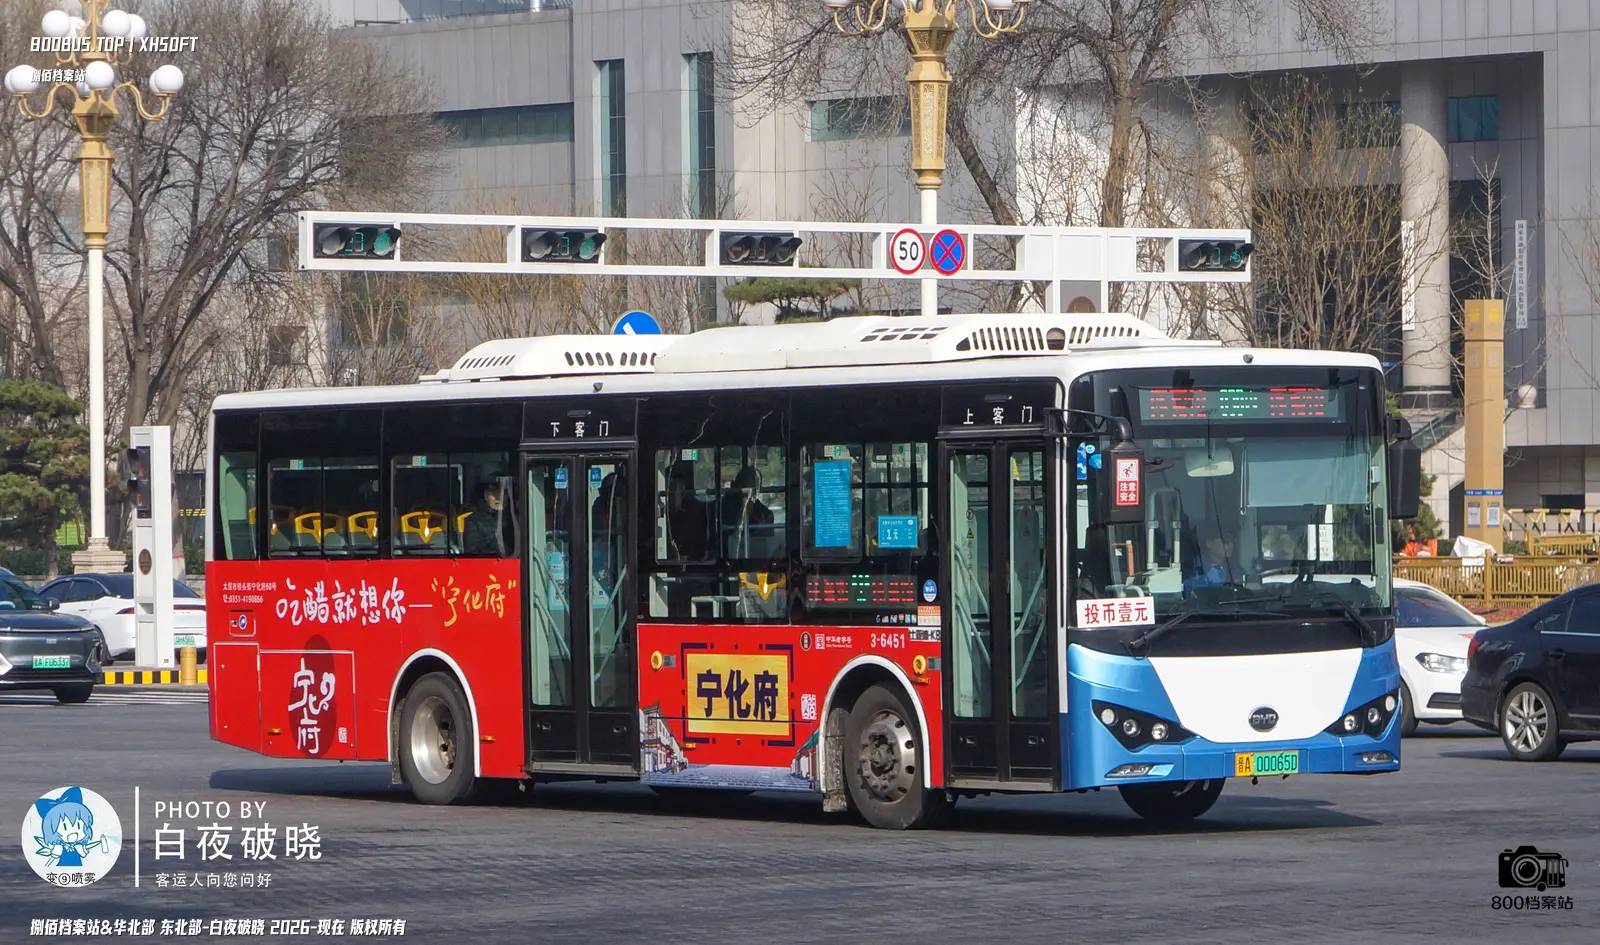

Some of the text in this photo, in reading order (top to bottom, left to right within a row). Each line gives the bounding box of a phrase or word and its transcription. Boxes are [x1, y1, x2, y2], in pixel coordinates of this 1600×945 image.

[899, 241, 919, 261] 50
[963, 406, 1033, 425] 上客门
[550, 420, 609, 437] 下客门
[1120, 482, 1136, 491] 注意
[1120, 492, 1136, 502] 安全
[1084, 601, 1149, 625] 投币壹元
[870, 633, 905, 649] 3-6451
[697, 669, 778, 721] 宁化府
[1252, 713, 1277, 725] BYD
